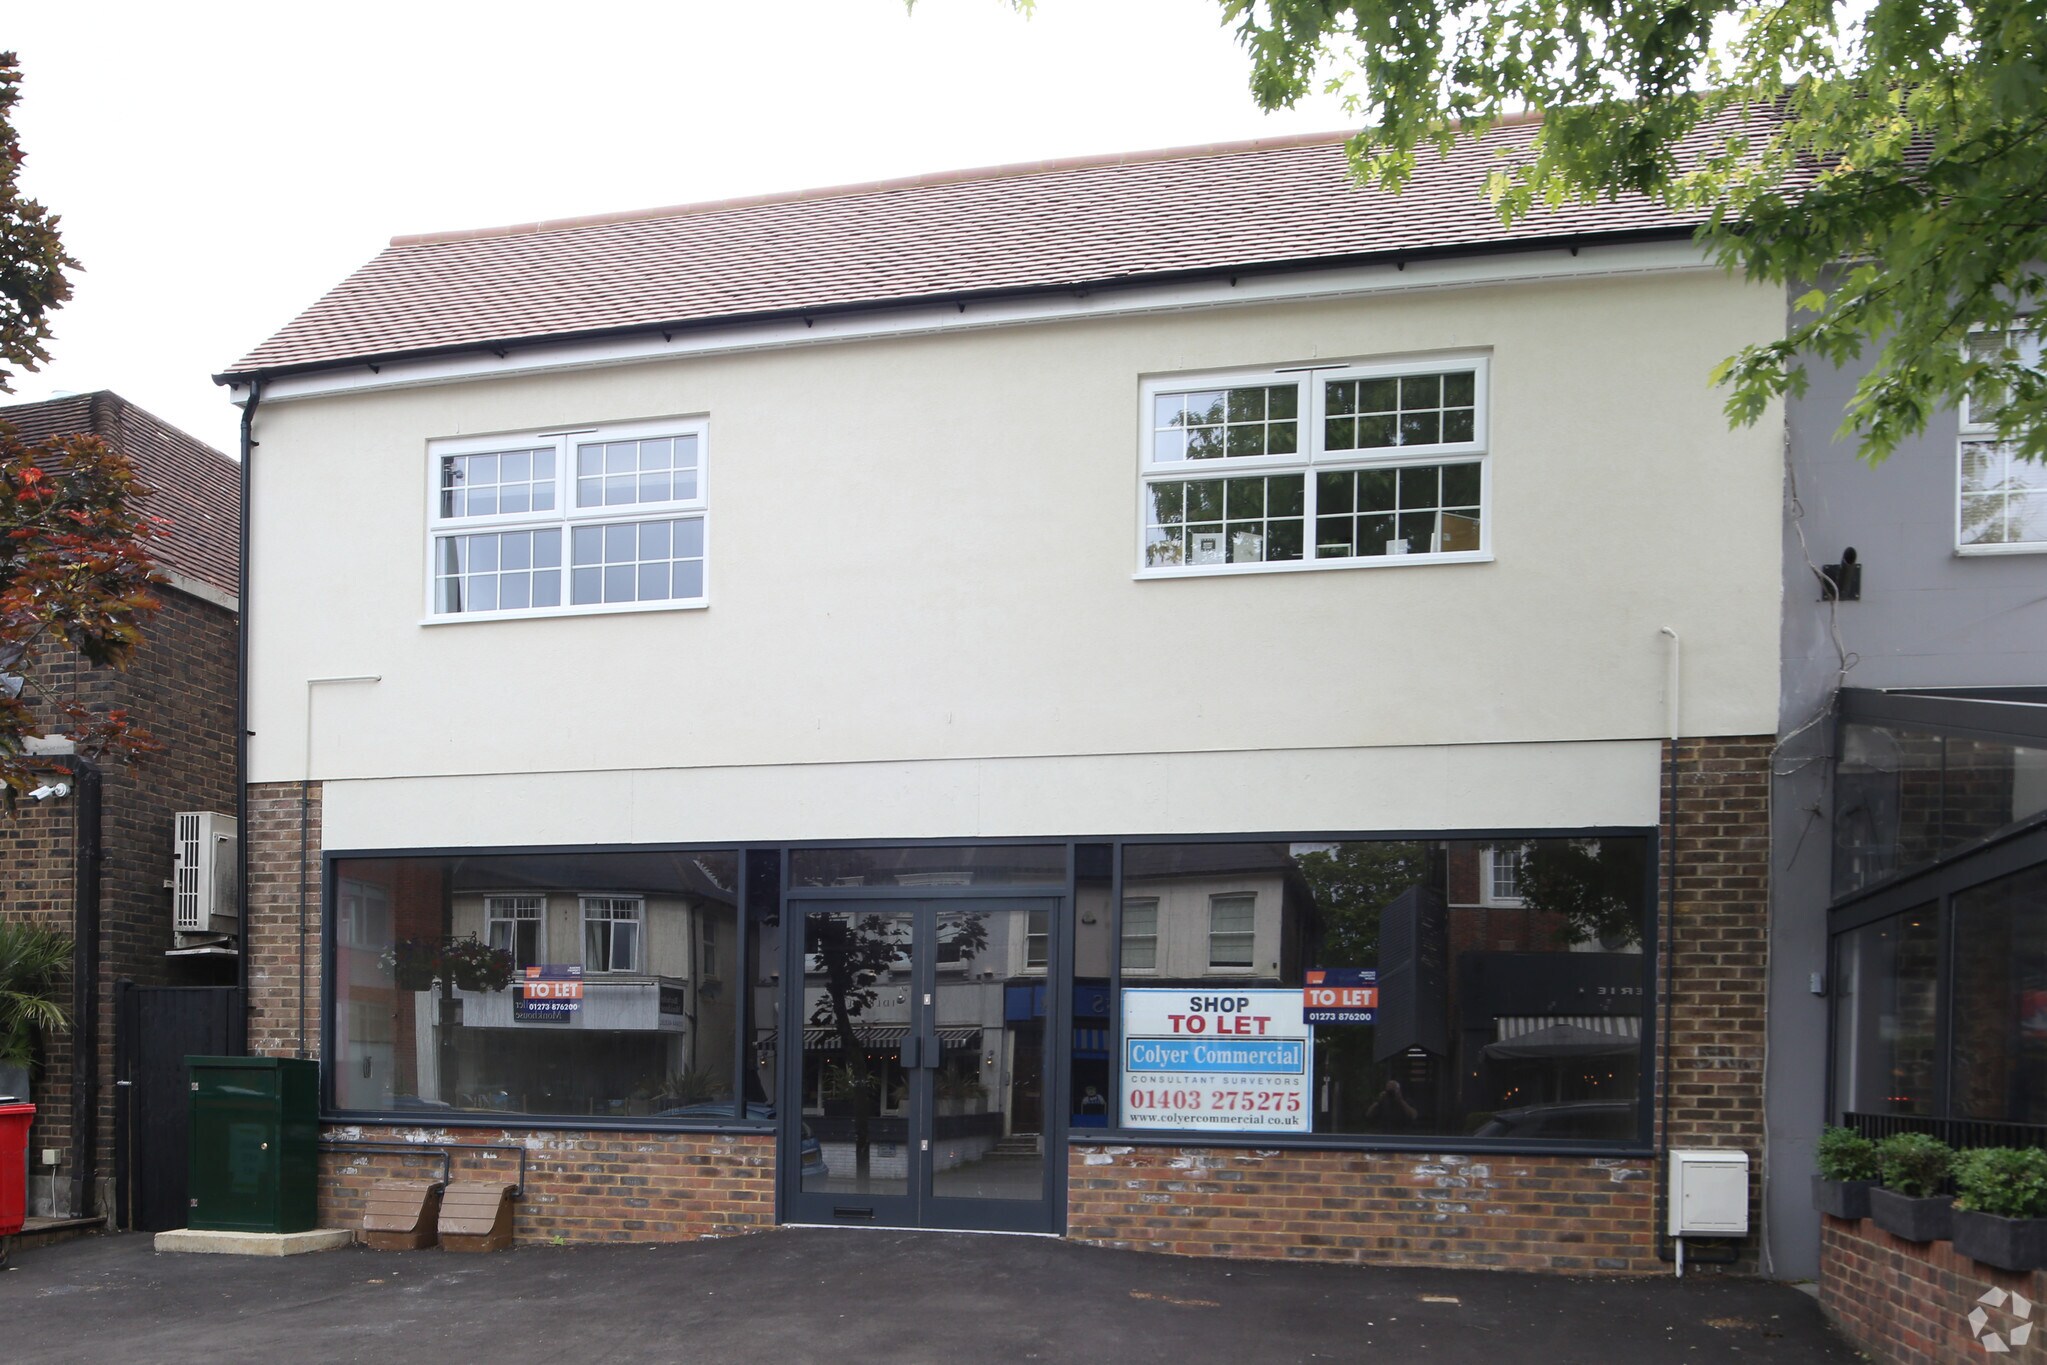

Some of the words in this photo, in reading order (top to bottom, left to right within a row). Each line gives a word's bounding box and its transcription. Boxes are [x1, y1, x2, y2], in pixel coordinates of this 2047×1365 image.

[529, 983, 550, 997] TO
[554, 983, 579, 997] LET
[1309, 989, 1336, 1006] TO
[1342, 989, 1373, 1006] LET
[528, 1003, 550, 1011] 01273
[551, 1003, 578, 1011] 876200
[1189, 996, 1250, 1013] SHOP
[1167, 1014, 1207, 1034] TO
[1217, 1015, 1272, 1035] LET
[1309, 1012, 1336, 1021] 01273
[1338, 1013, 1372, 1021] 876200
[1132, 1044, 1189, 1067] Colyer
[1193, 1046, 1299, 1065] Commercial
[1131, 1075, 1216, 1085] CONSULTANT
[1223, 1076, 1300, 1086] SURVEYORS
[1130, 1089, 1202, 1110] 01403
[1211, 1090, 1301, 1112] 275275
